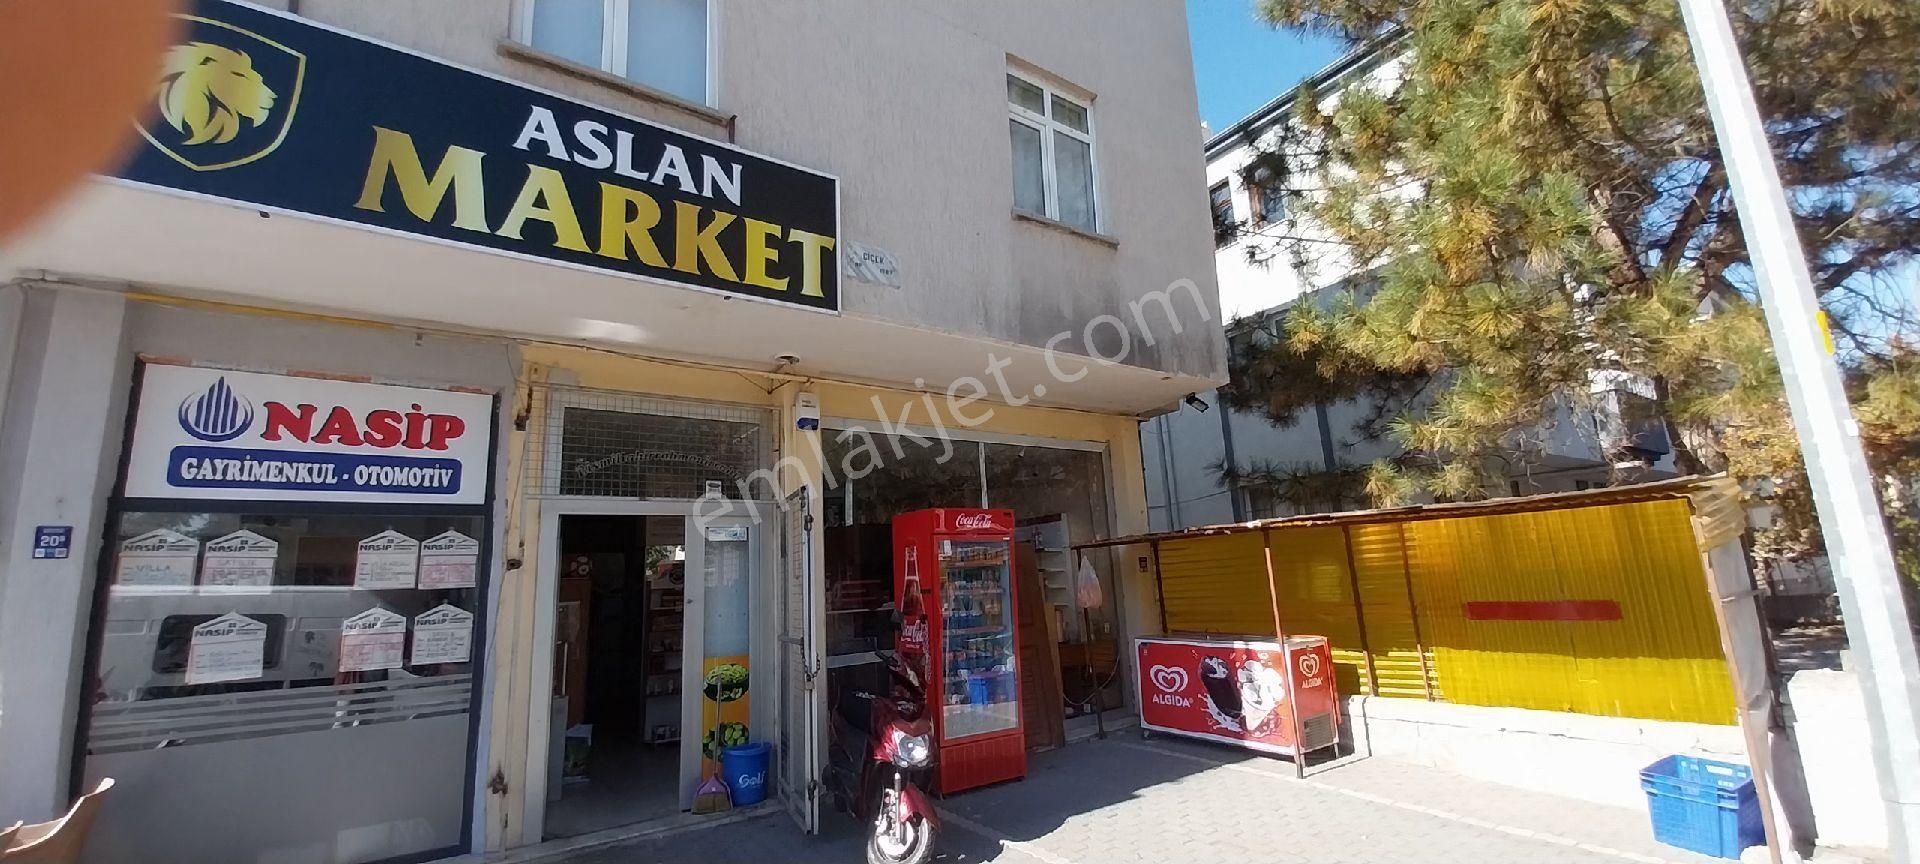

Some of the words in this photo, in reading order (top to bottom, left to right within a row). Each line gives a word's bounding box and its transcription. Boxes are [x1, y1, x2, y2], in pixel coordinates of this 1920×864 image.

[512, 104, 742, 207] ASLAN
[354, 125, 835, 298] MARKET
[260, 401, 465, 451] NASİP
[181, 455, 338, 484] GAYRİMENKUL
[354, 463, 453, 488] OTOMOTİV
[1152, 694, 1191, 708] ALGIDA
[1302, 677, 1322, 688] ALGIDA
